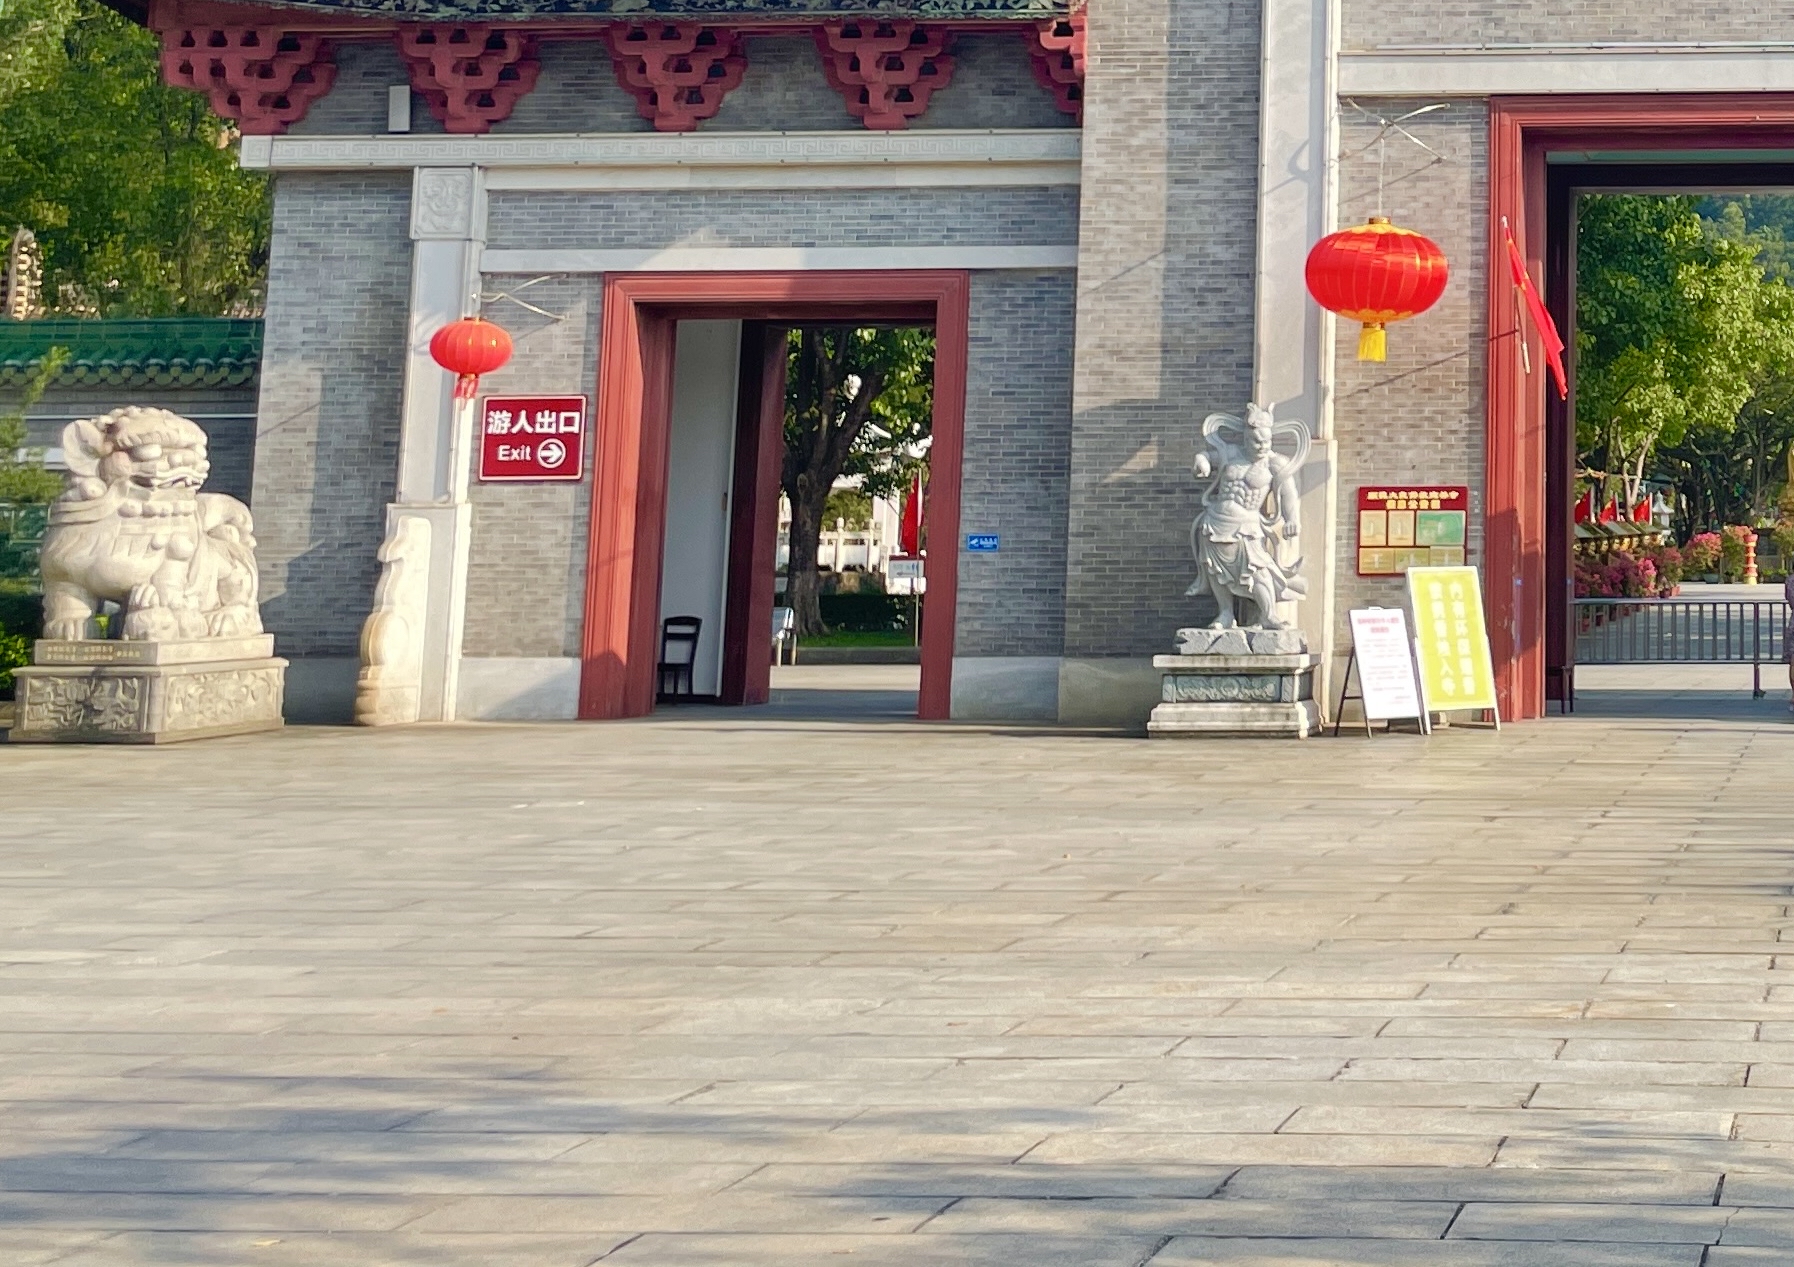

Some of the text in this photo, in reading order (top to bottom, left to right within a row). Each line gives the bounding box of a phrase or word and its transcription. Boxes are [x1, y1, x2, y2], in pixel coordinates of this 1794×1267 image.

[487, 409, 581, 434] 游人出口
[497, 444, 532, 461] Exit
